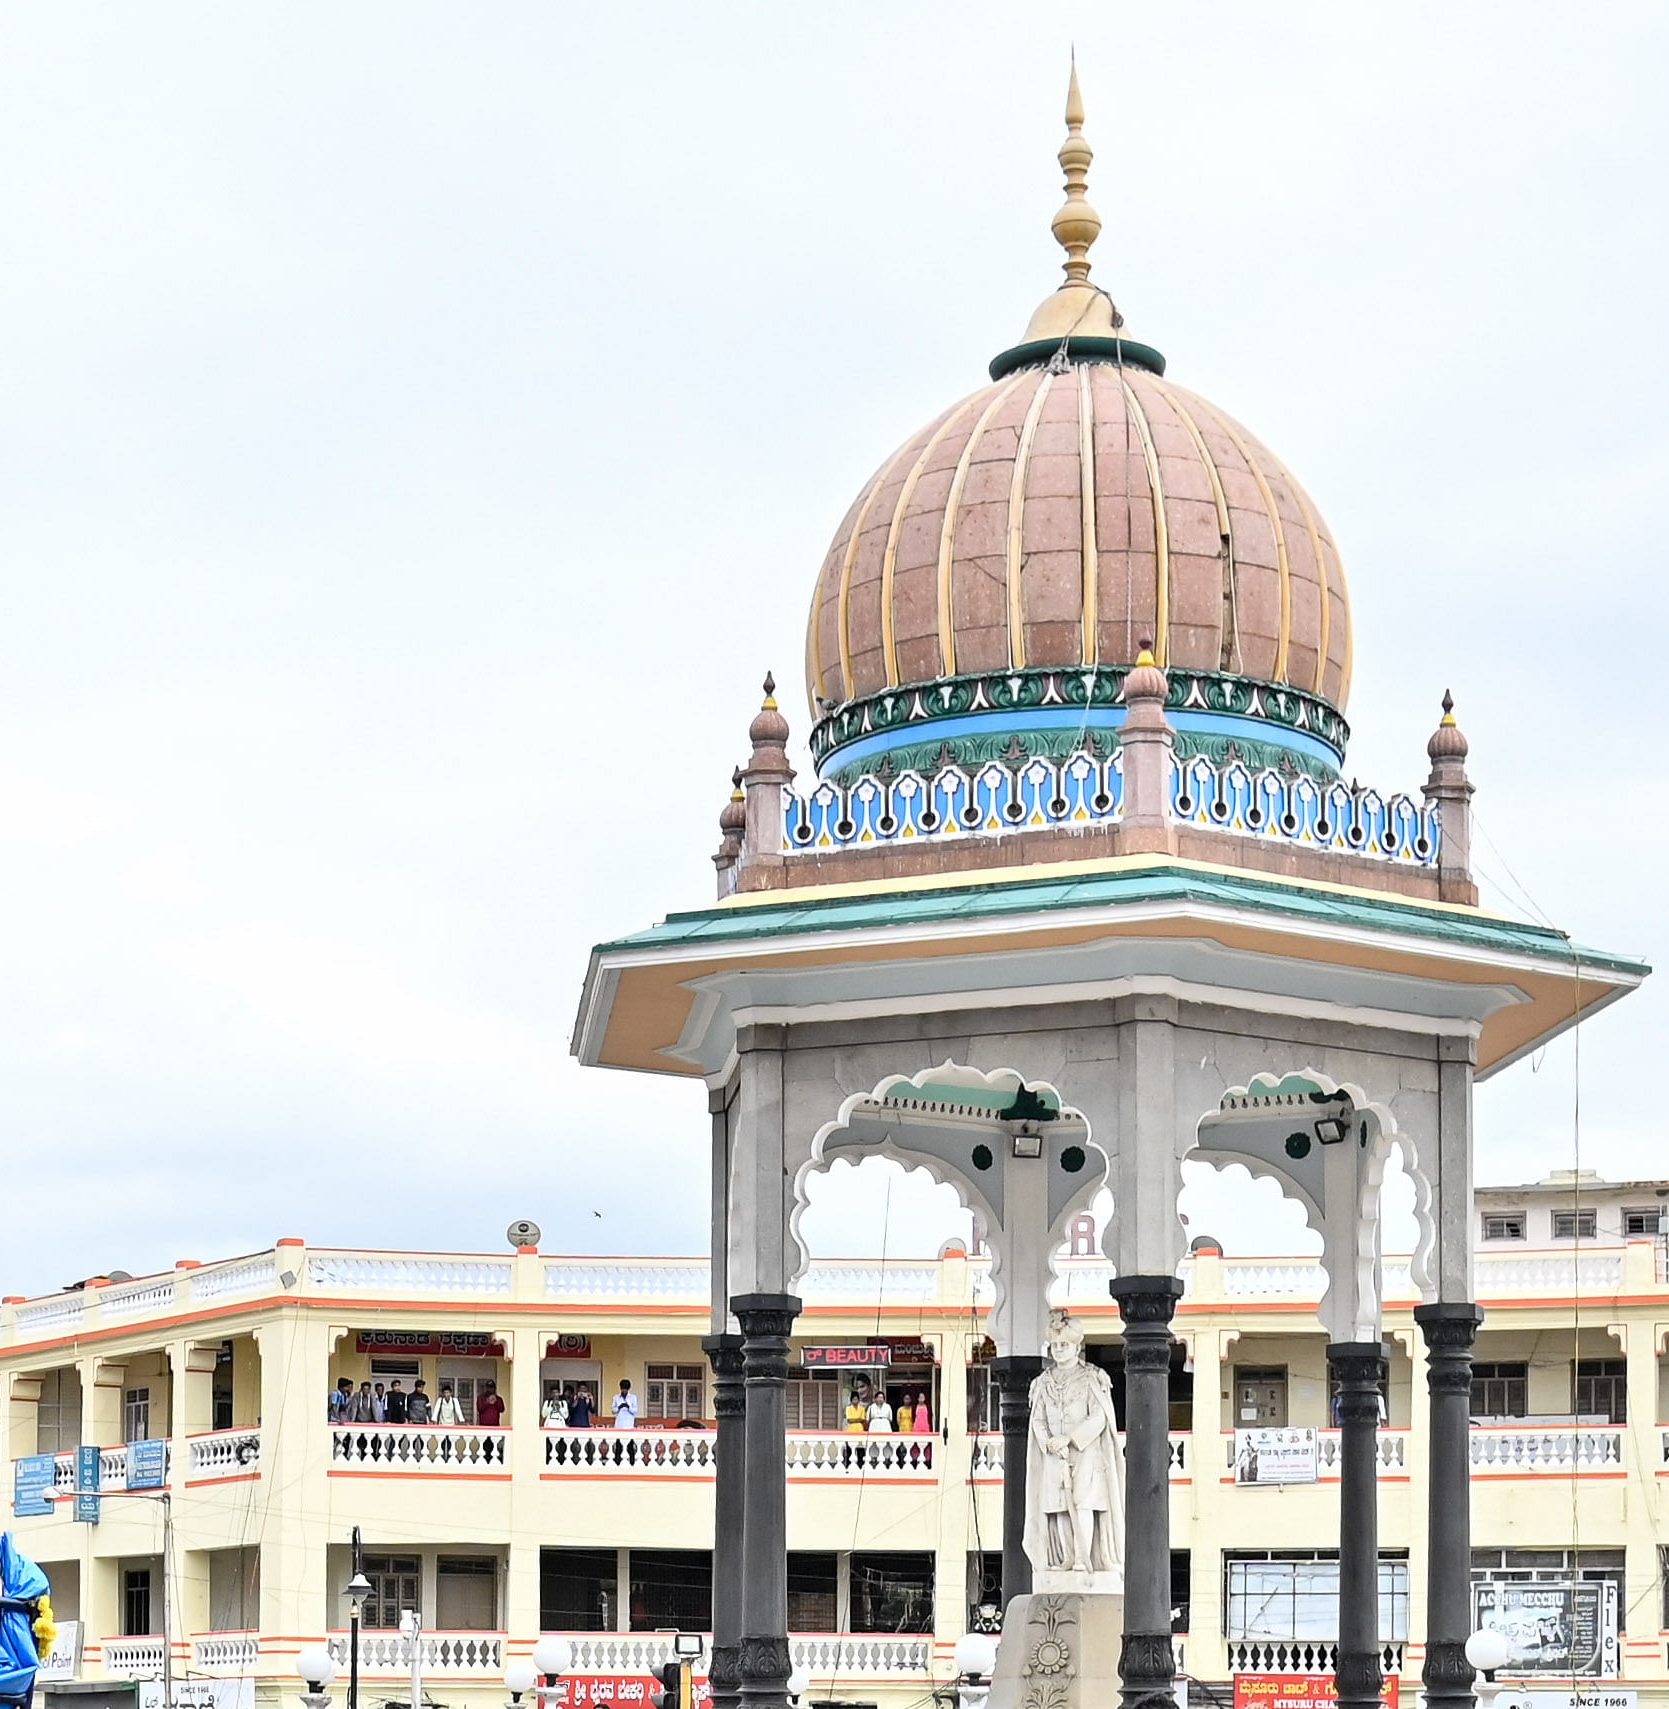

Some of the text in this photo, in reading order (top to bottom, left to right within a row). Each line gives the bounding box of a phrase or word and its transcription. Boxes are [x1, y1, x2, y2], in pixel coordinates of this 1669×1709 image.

[826, 1348, 888, 1363] BEAUTY
[1521, 1592, 1564, 1607] MECCHU
[1274, 1699, 1313, 1708] MYSURU
[1569, 1698, 1600, 1707] SINCE
